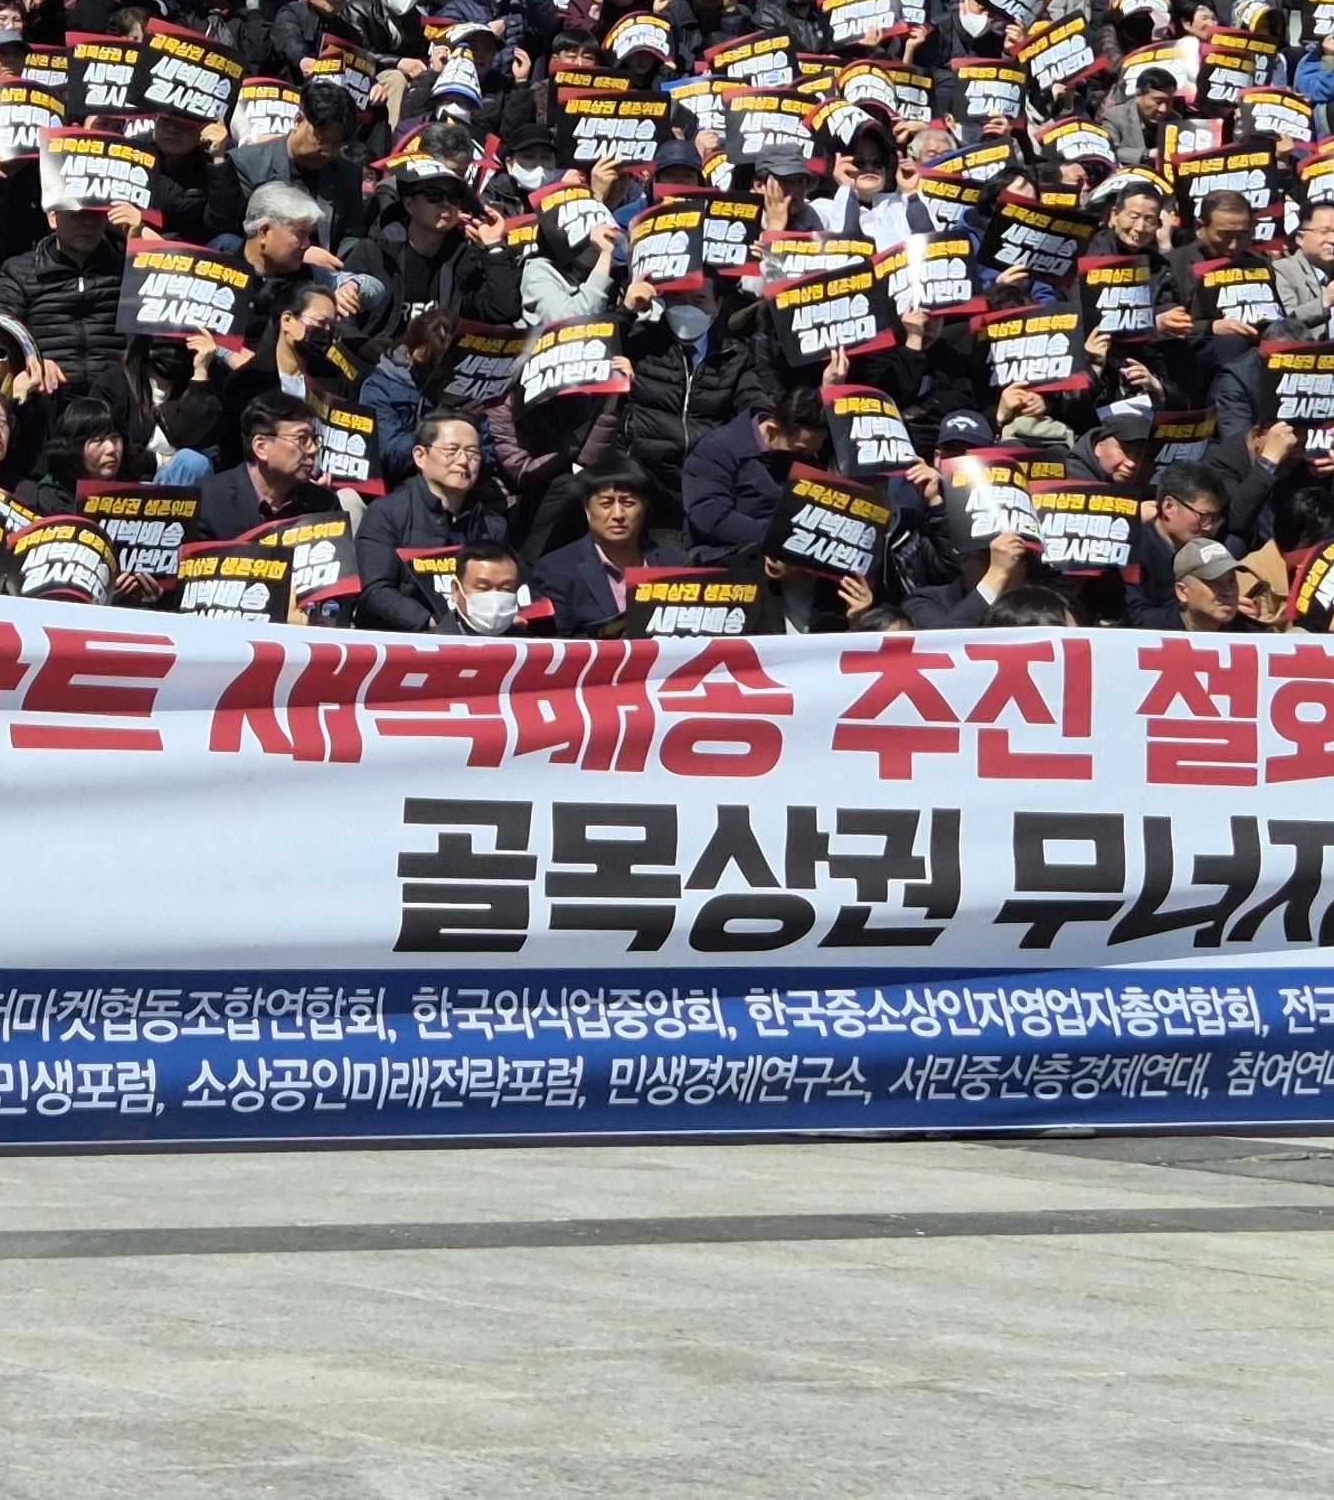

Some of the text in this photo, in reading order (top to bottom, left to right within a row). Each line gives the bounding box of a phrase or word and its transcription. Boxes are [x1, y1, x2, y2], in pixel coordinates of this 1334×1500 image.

[144, 77, 228, 119] 결사반대
[149, 55, 232, 100] 새벽배송
[137, 273, 235, 309] 새벽배송
[791, 293, 869, 331] 새벽배송
[136, 298, 234, 335] 결사반대
[798, 315, 876, 354] 결사반대
[790, 503, 877, 550] 새벽배송
[1041, 513, 1130, 540] 새벽배송
[783, 527, 873, 576] 결사반대
[1041, 537, 1131, 566] 결사반대
[209, 638, 794, 778] 새벽배송
[832, 637, 1093, 781] 추진
[394, 796, 961, 954] 골목상권
[412, 986, 737, 1042] 한국외식업중앙회,
[745, 987, 1269, 1041] 한국중소상인자영업자총연합회,
[182, 1055, 586, 1111] 소상공인미래전략포럼,
[608, 1054, 873, 1105] 민생경제연구소,
[888, 1051, 1212, 1102] 서민중산층경제연대,
